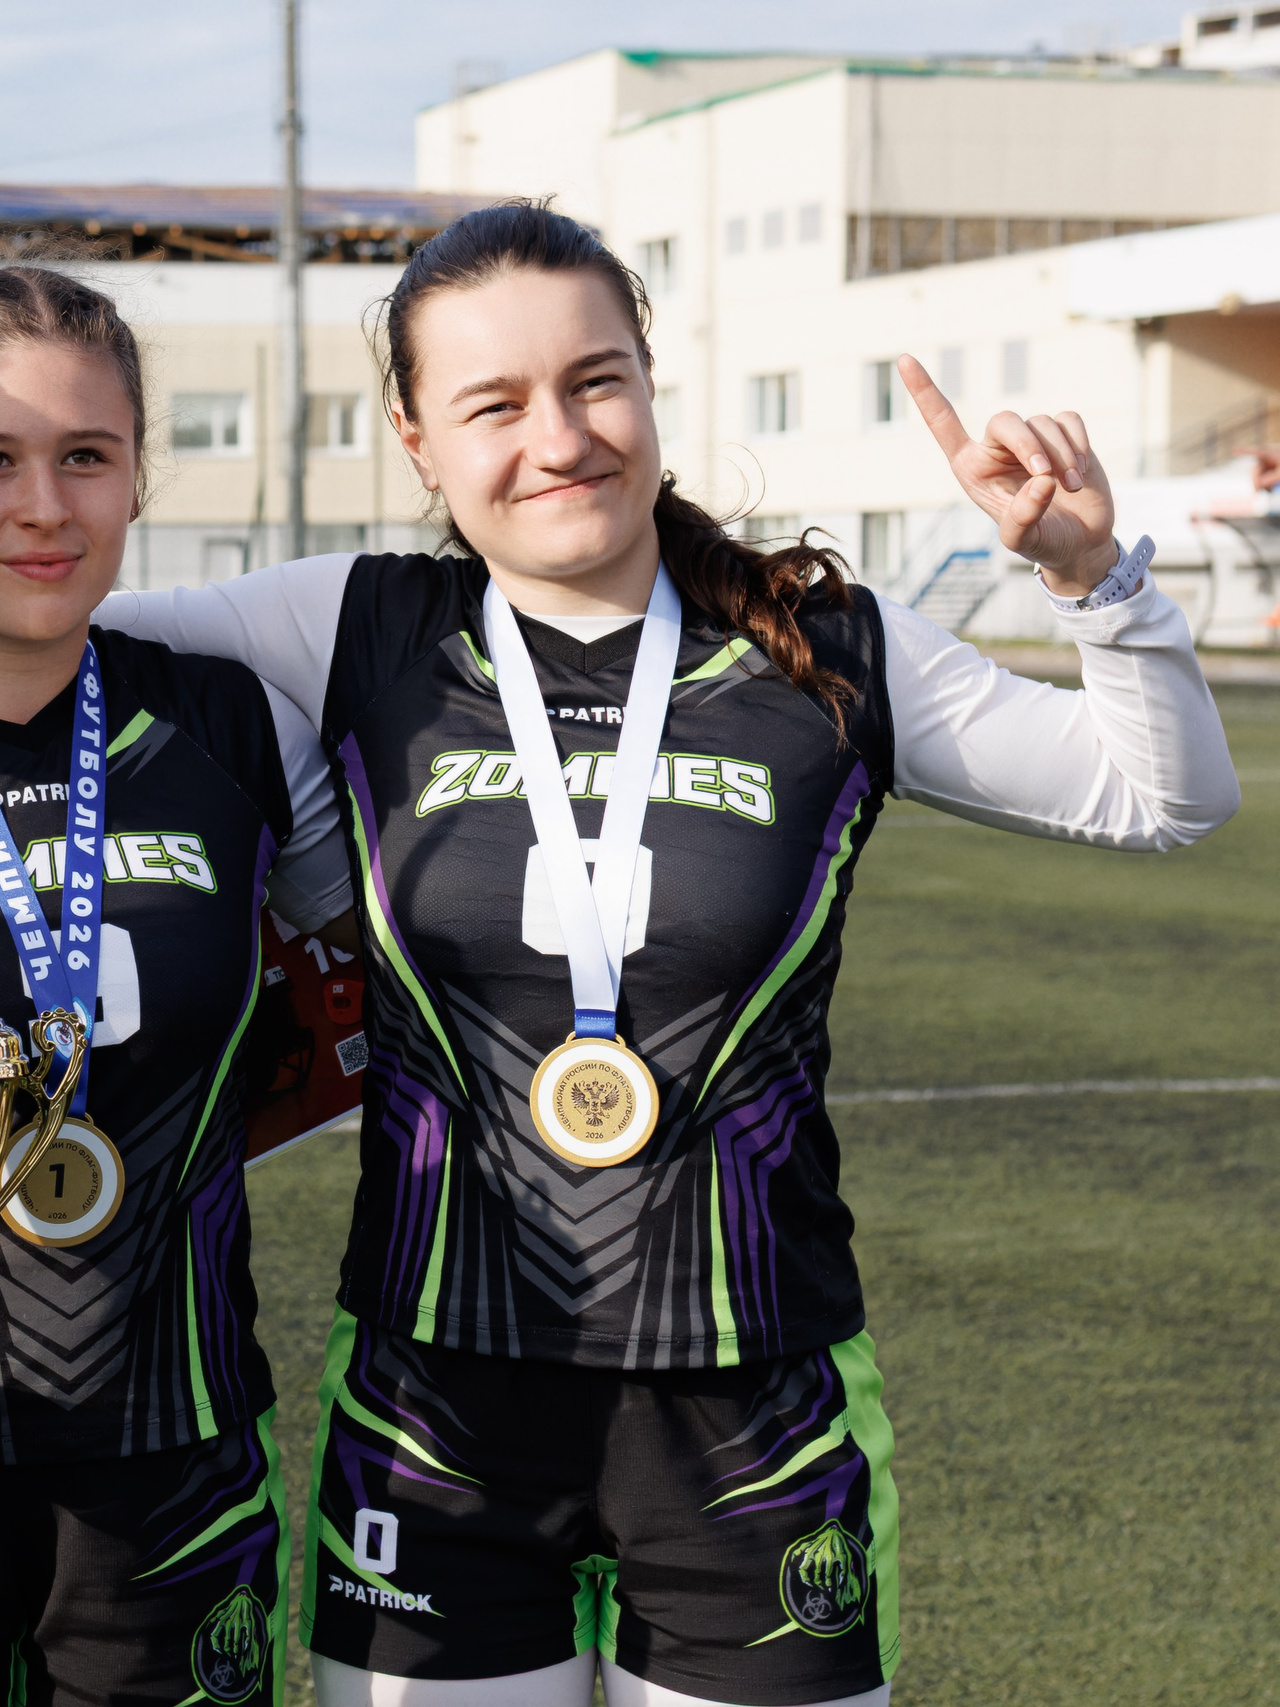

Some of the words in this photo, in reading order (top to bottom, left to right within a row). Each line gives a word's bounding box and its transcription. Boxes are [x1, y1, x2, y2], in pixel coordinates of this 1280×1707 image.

[67, 871, 94, 971] 2026
[556, 1080, 572, 1131] ЧЕМПИОНАТ
[566, 1062, 598, 1082] РОССИИ
[598, 1063, 611, 1073] ПО
[65, 1143, 78, 1151] ПО
[585, 1131, 604, 1139] 2026
[49, 1163, 65, 1198] 1
[345, 1580, 433, 1613] PATRICK
